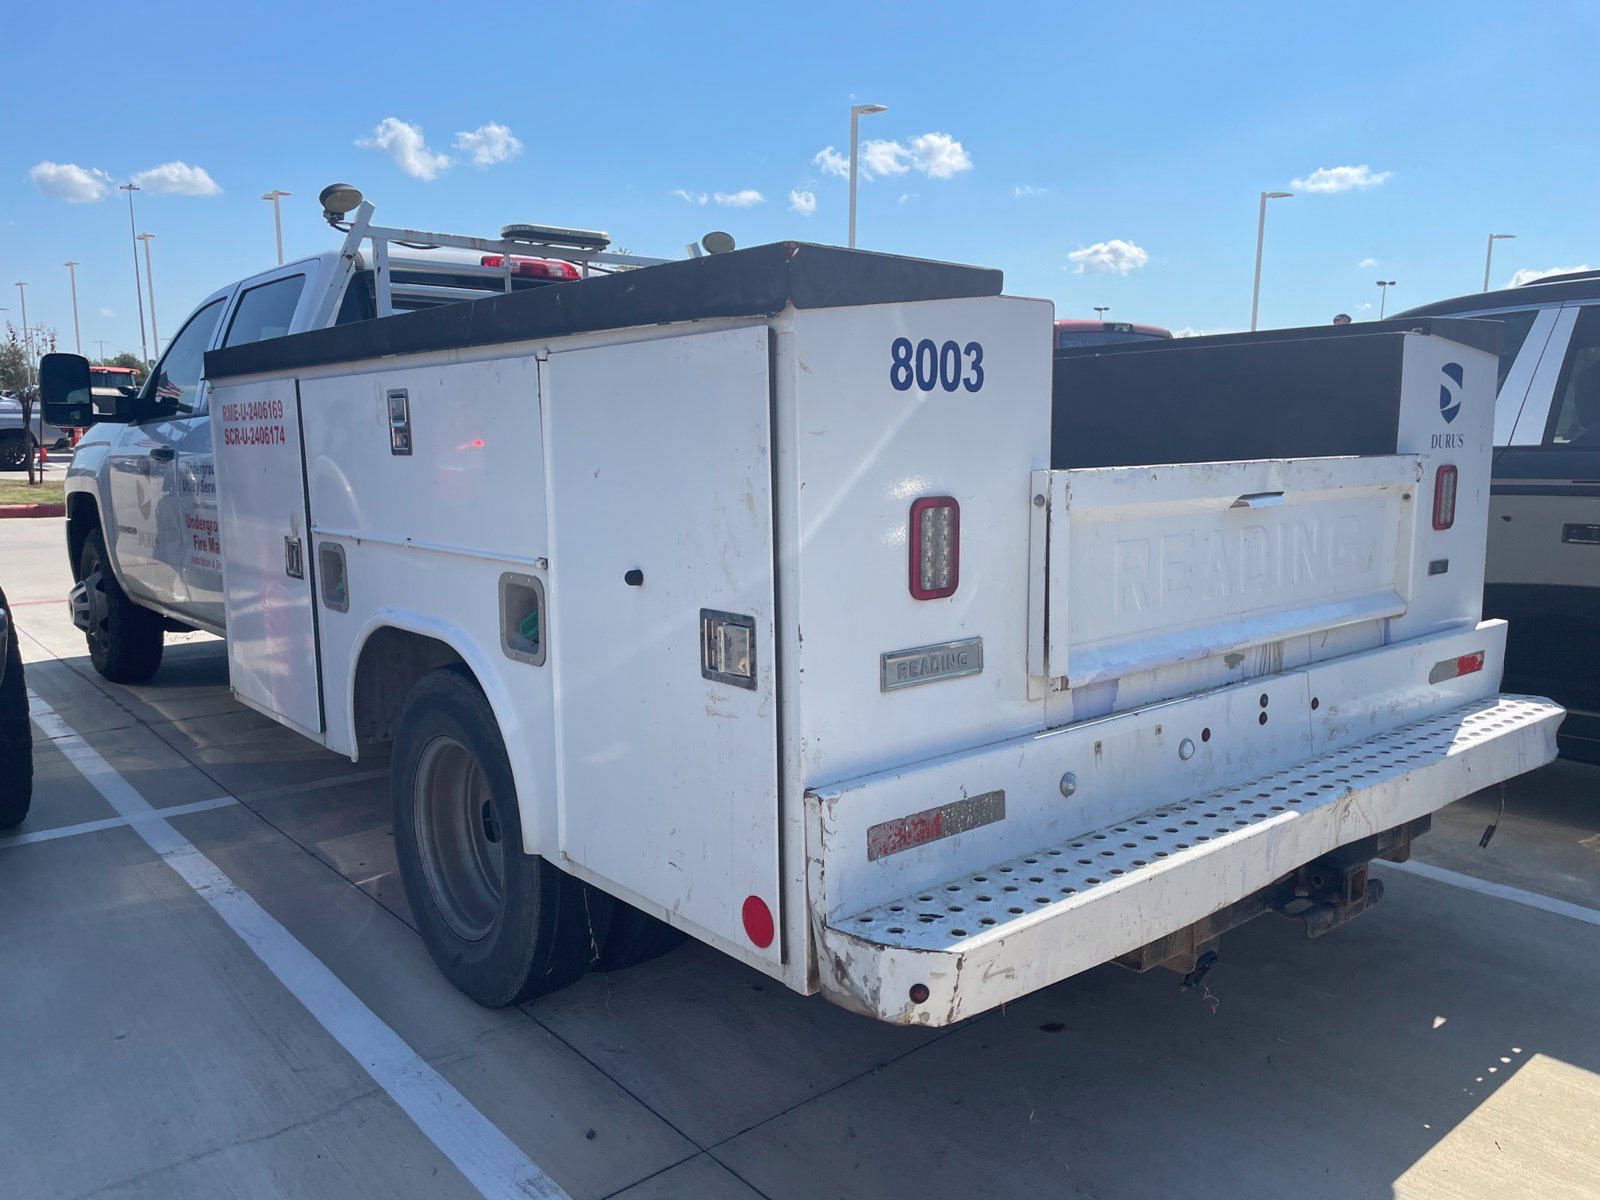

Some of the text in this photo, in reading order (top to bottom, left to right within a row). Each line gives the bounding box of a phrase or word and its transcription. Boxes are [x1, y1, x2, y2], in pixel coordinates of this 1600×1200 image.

[890, 337, 984, 392] 8003
[222, 400, 283, 421] RME-U-2406169
[224, 426, 285, 445] SCR-U-2406174
[1431, 433, 1464, 449] DURUS
[193, 534, 207, 551] Fire
[1113, 515, 1366, 615] READING
[897, 651, 968, 680] READING
